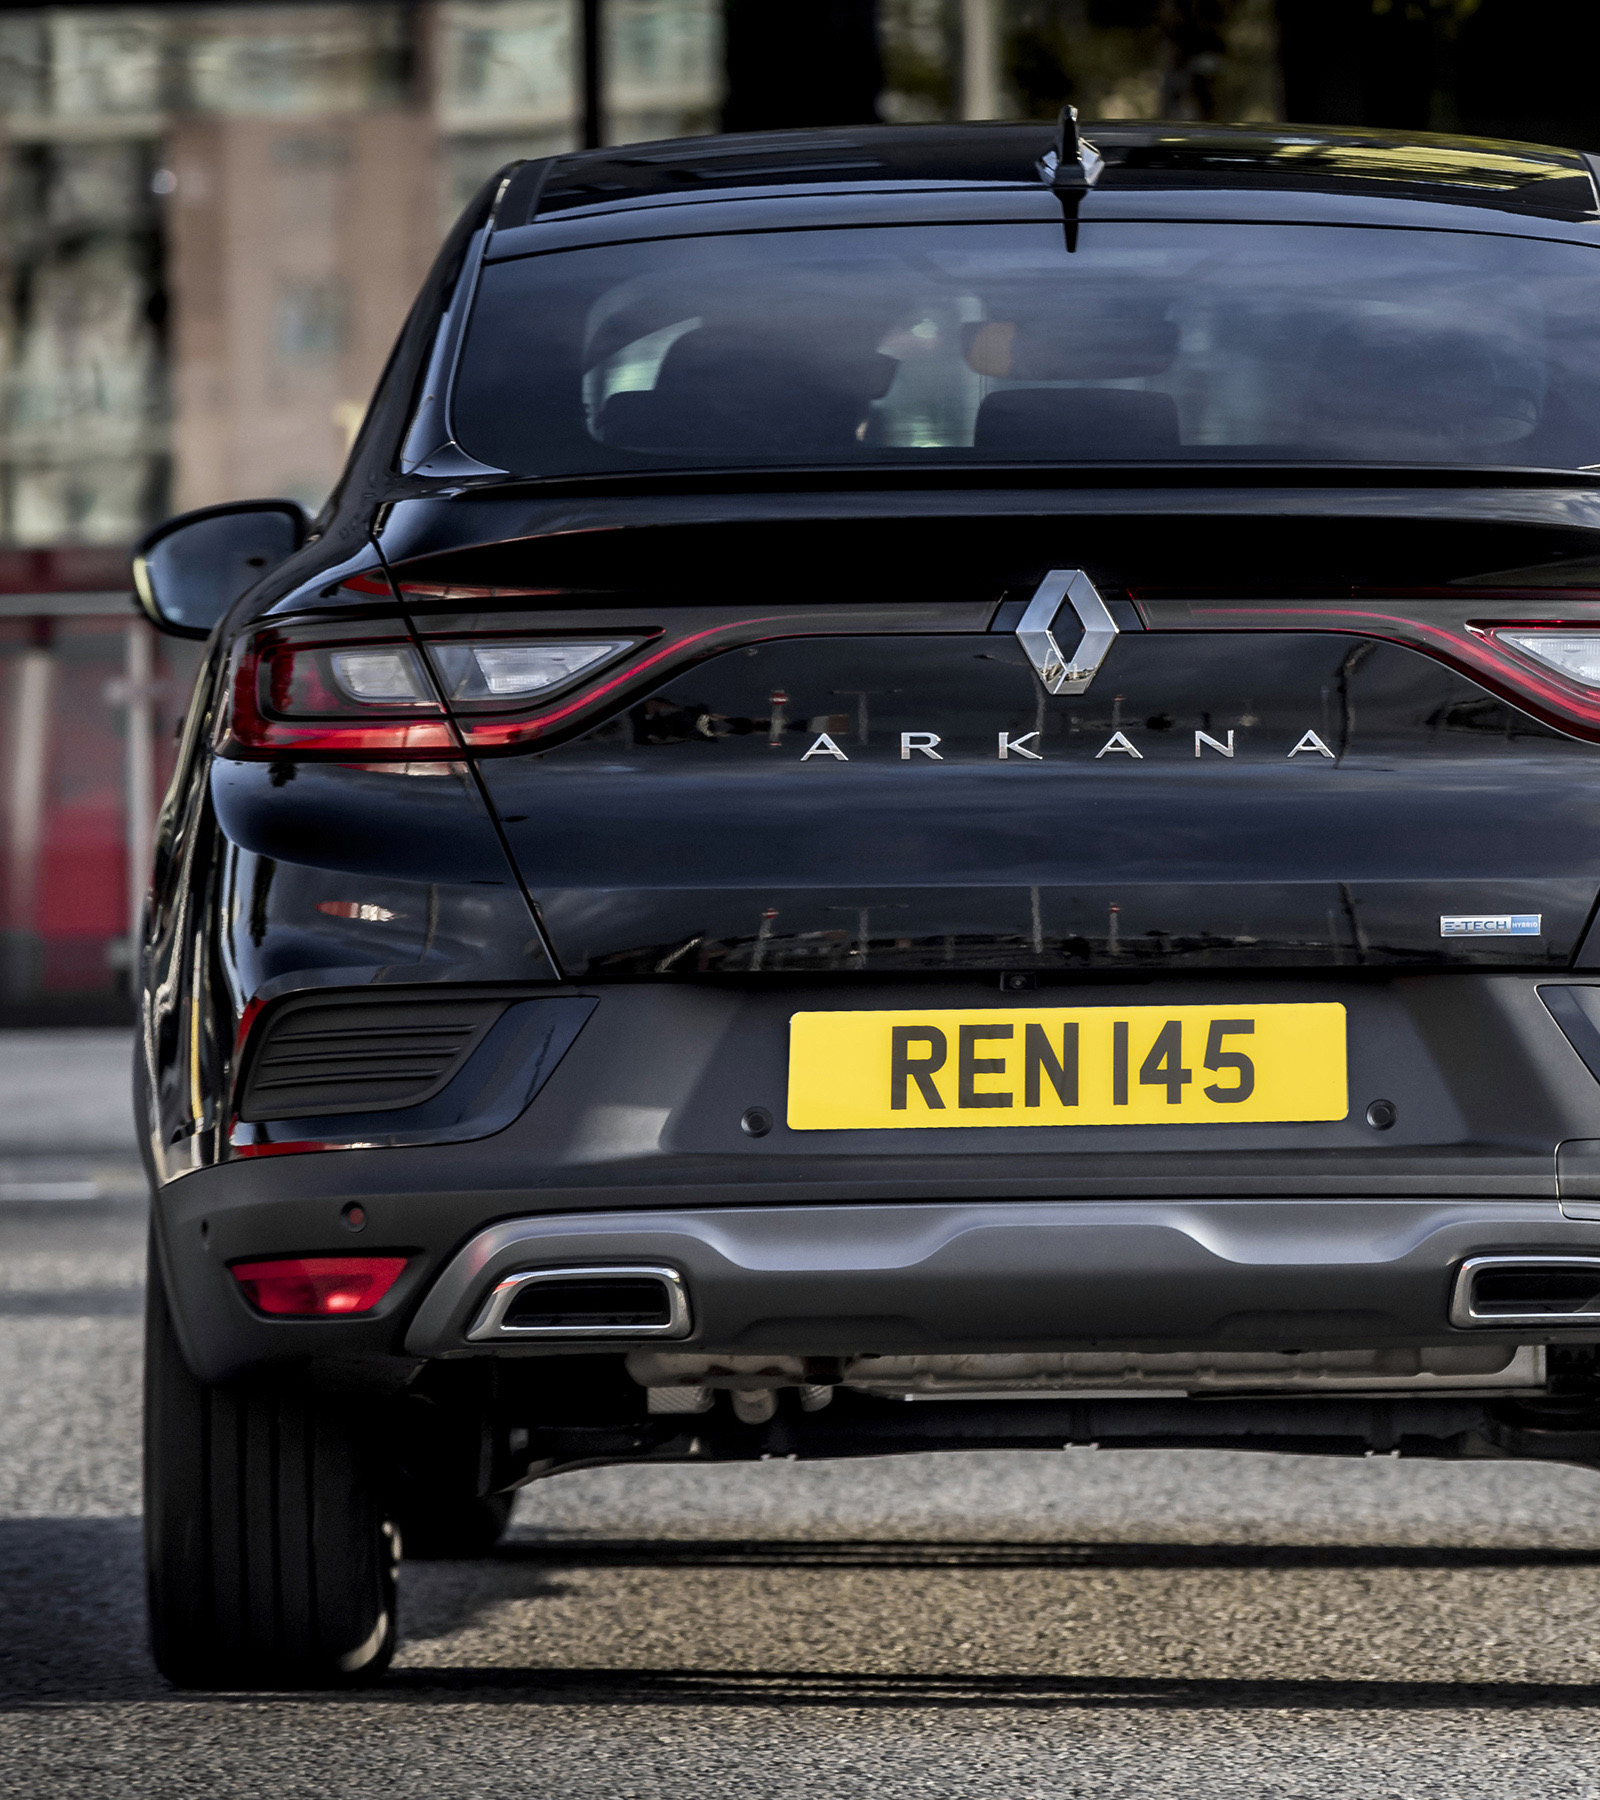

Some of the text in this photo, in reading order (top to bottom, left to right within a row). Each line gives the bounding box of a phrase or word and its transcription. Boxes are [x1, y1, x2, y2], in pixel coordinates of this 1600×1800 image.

[801, 729, 1336, 761] ARKANA
[1444, 920, 1538, 931] E-TECH HYBRID
[890, 1019, 1256, 1110] REN 145
